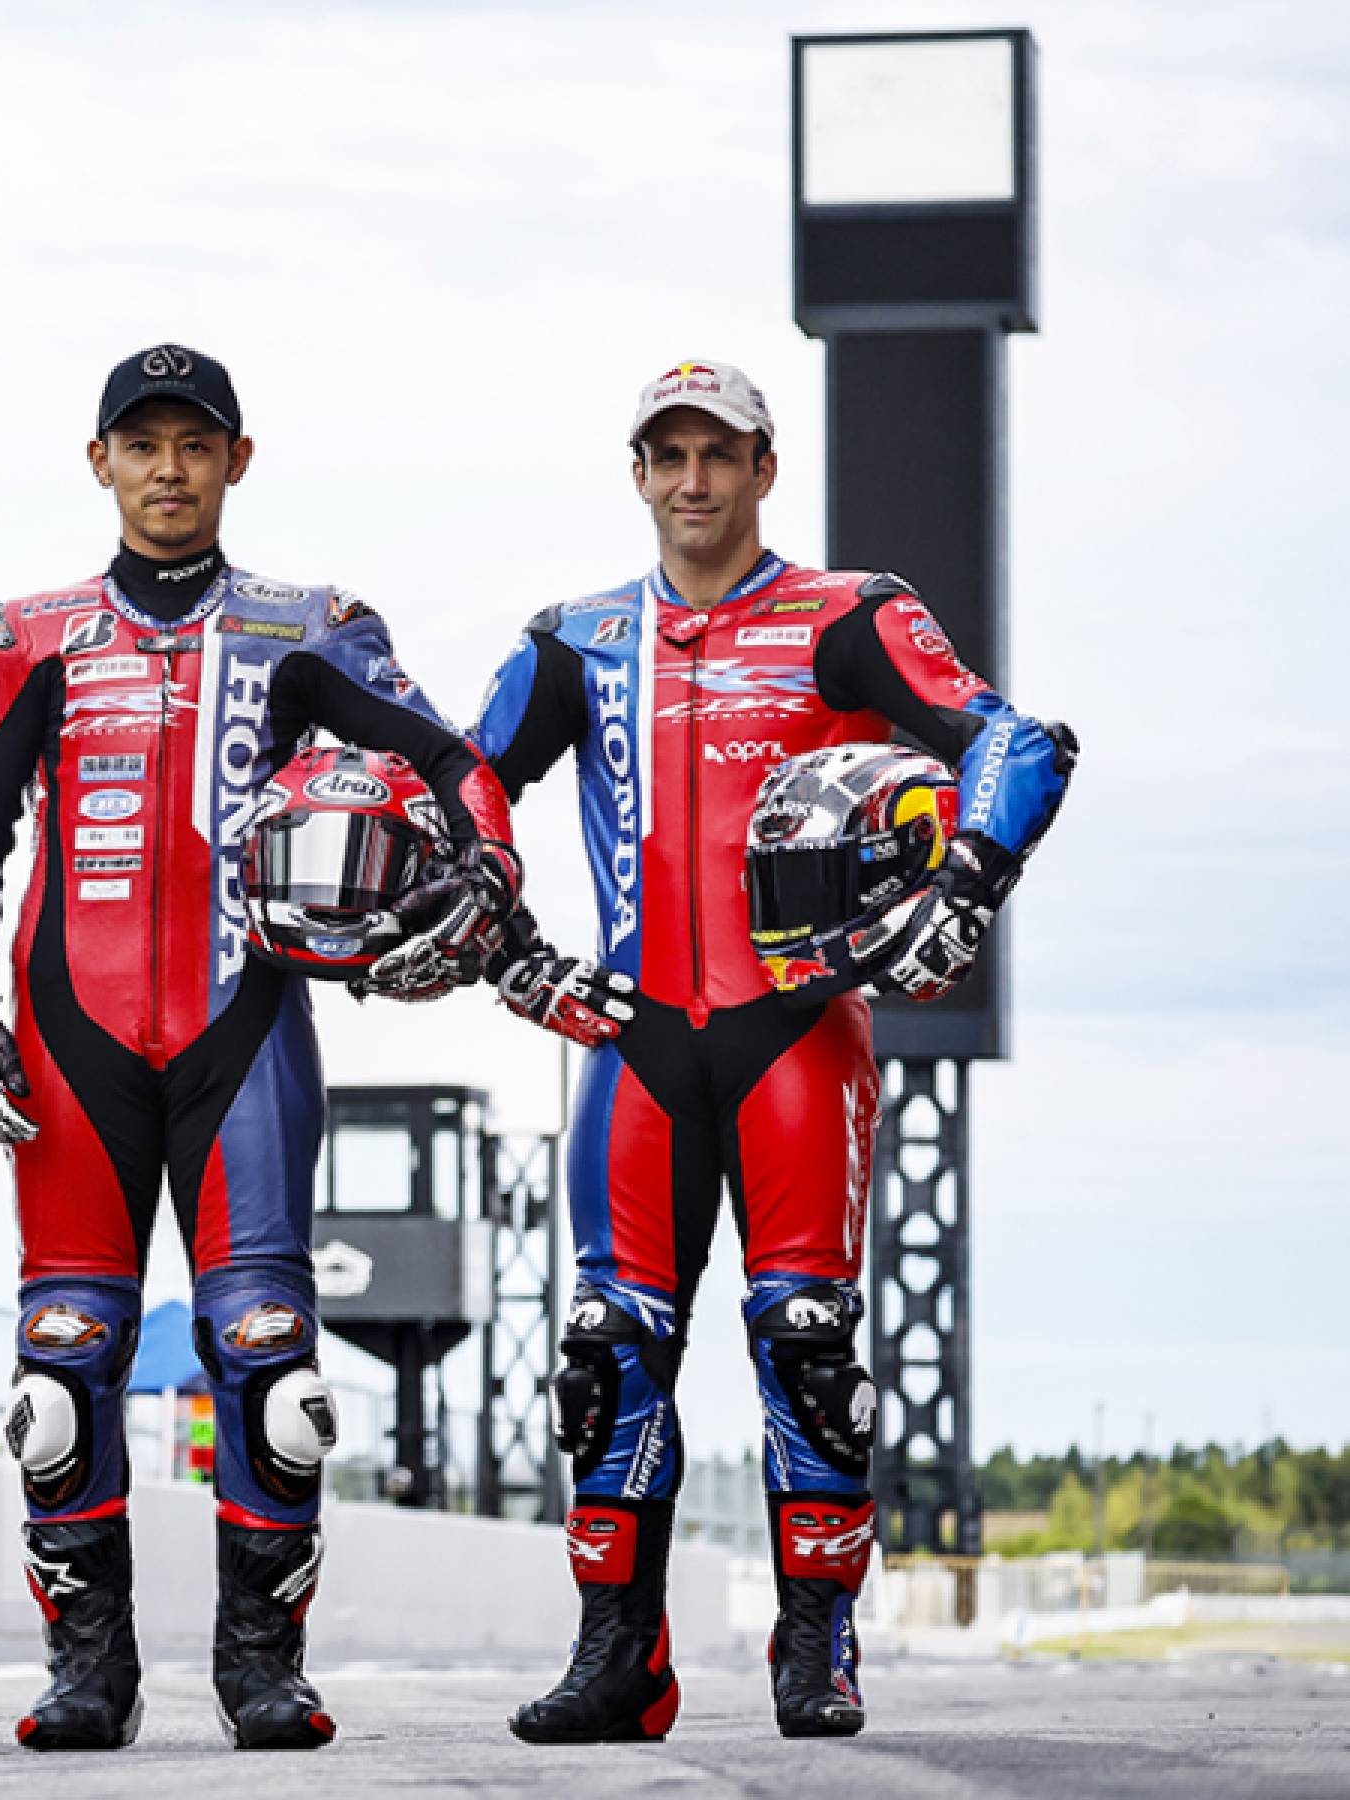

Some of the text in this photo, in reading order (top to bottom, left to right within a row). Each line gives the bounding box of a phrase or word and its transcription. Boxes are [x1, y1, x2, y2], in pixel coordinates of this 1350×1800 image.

[653, 380, 721, 401] Red Bull
[218, 654, 272, 985] HONDA
[595, 662, 637, 953] HONDA
[968, 721, 1016, 826] HONDA
